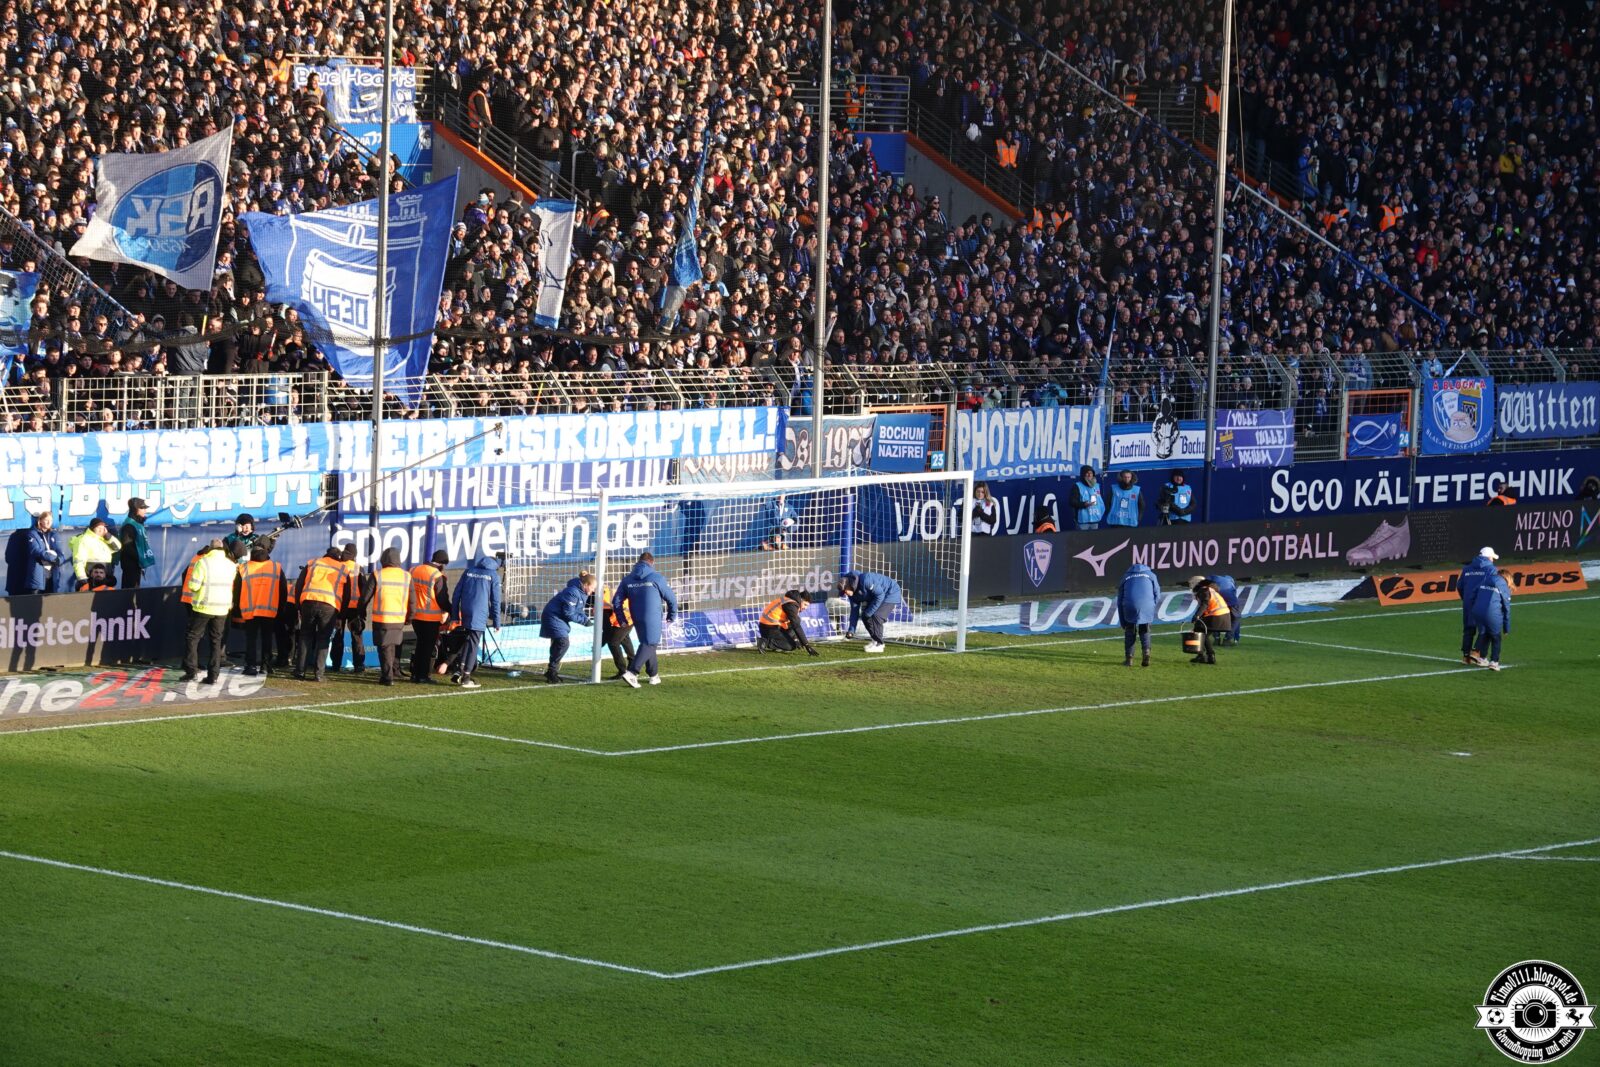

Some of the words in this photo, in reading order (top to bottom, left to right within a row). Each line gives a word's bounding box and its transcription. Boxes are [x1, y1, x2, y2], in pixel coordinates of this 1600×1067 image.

[294, 67, 341, 86] Bue
[342, 68, 416, 87] Heats
[313, 286, 369, 330] 4630
[1499, 388, 1597, 435] Witten
[879, 425, 925, 441] BOCHUM
[957, 407, 1103, 471] PHOTOMAFIA
[1400, 433, 1409, 446] 24
[96, 424, 320, 483] FUSSBALL
[326, 416, 474, 474] BLEIBT
[481, 406, 777, 465] RISIKOKAPITAL!
[878, 444, 924, 459] NAZIFREI
[931, 452, 944, 467] 23
[986, 463, 1073, 477] BOCHUM
[1270, 468, 1343, 514] Seco
[1354, 467, 1575, 508] KÄLTETECHNIK
[1515, 509, 1574, 531] MIZUNO
[1132, 539, 1219, 570] MIZUNO
[1228, 532, 1339, 565] FOOTBALL
[1514, 530, 1571, 551] ALPHA
[802, 616, 825, 629] Tor
